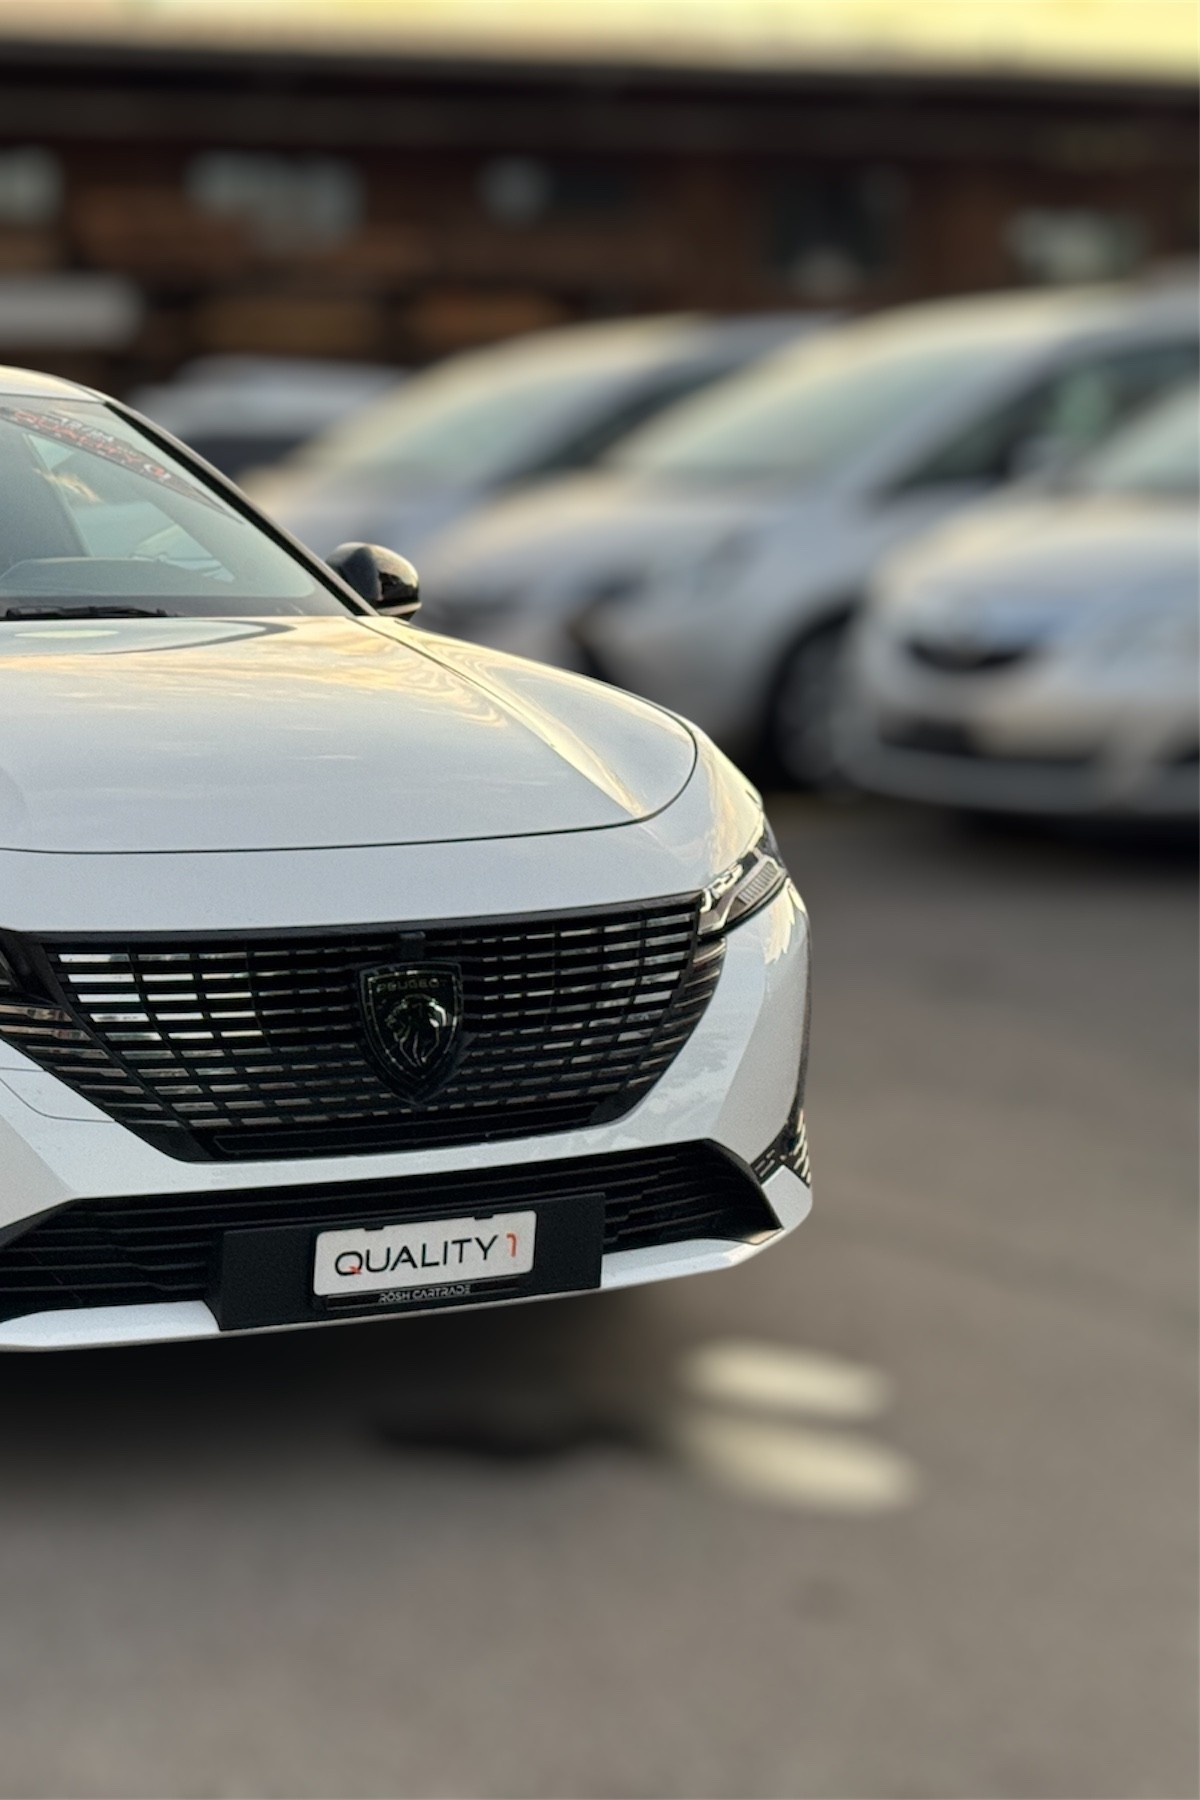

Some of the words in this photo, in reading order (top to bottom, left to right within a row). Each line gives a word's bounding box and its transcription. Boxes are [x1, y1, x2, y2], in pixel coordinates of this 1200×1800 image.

[334, 1234, 498, 1276] QUALITY
[506, 1232, 517, 1257] 1
[412, 1284, 471, 1299] CARTRADE
